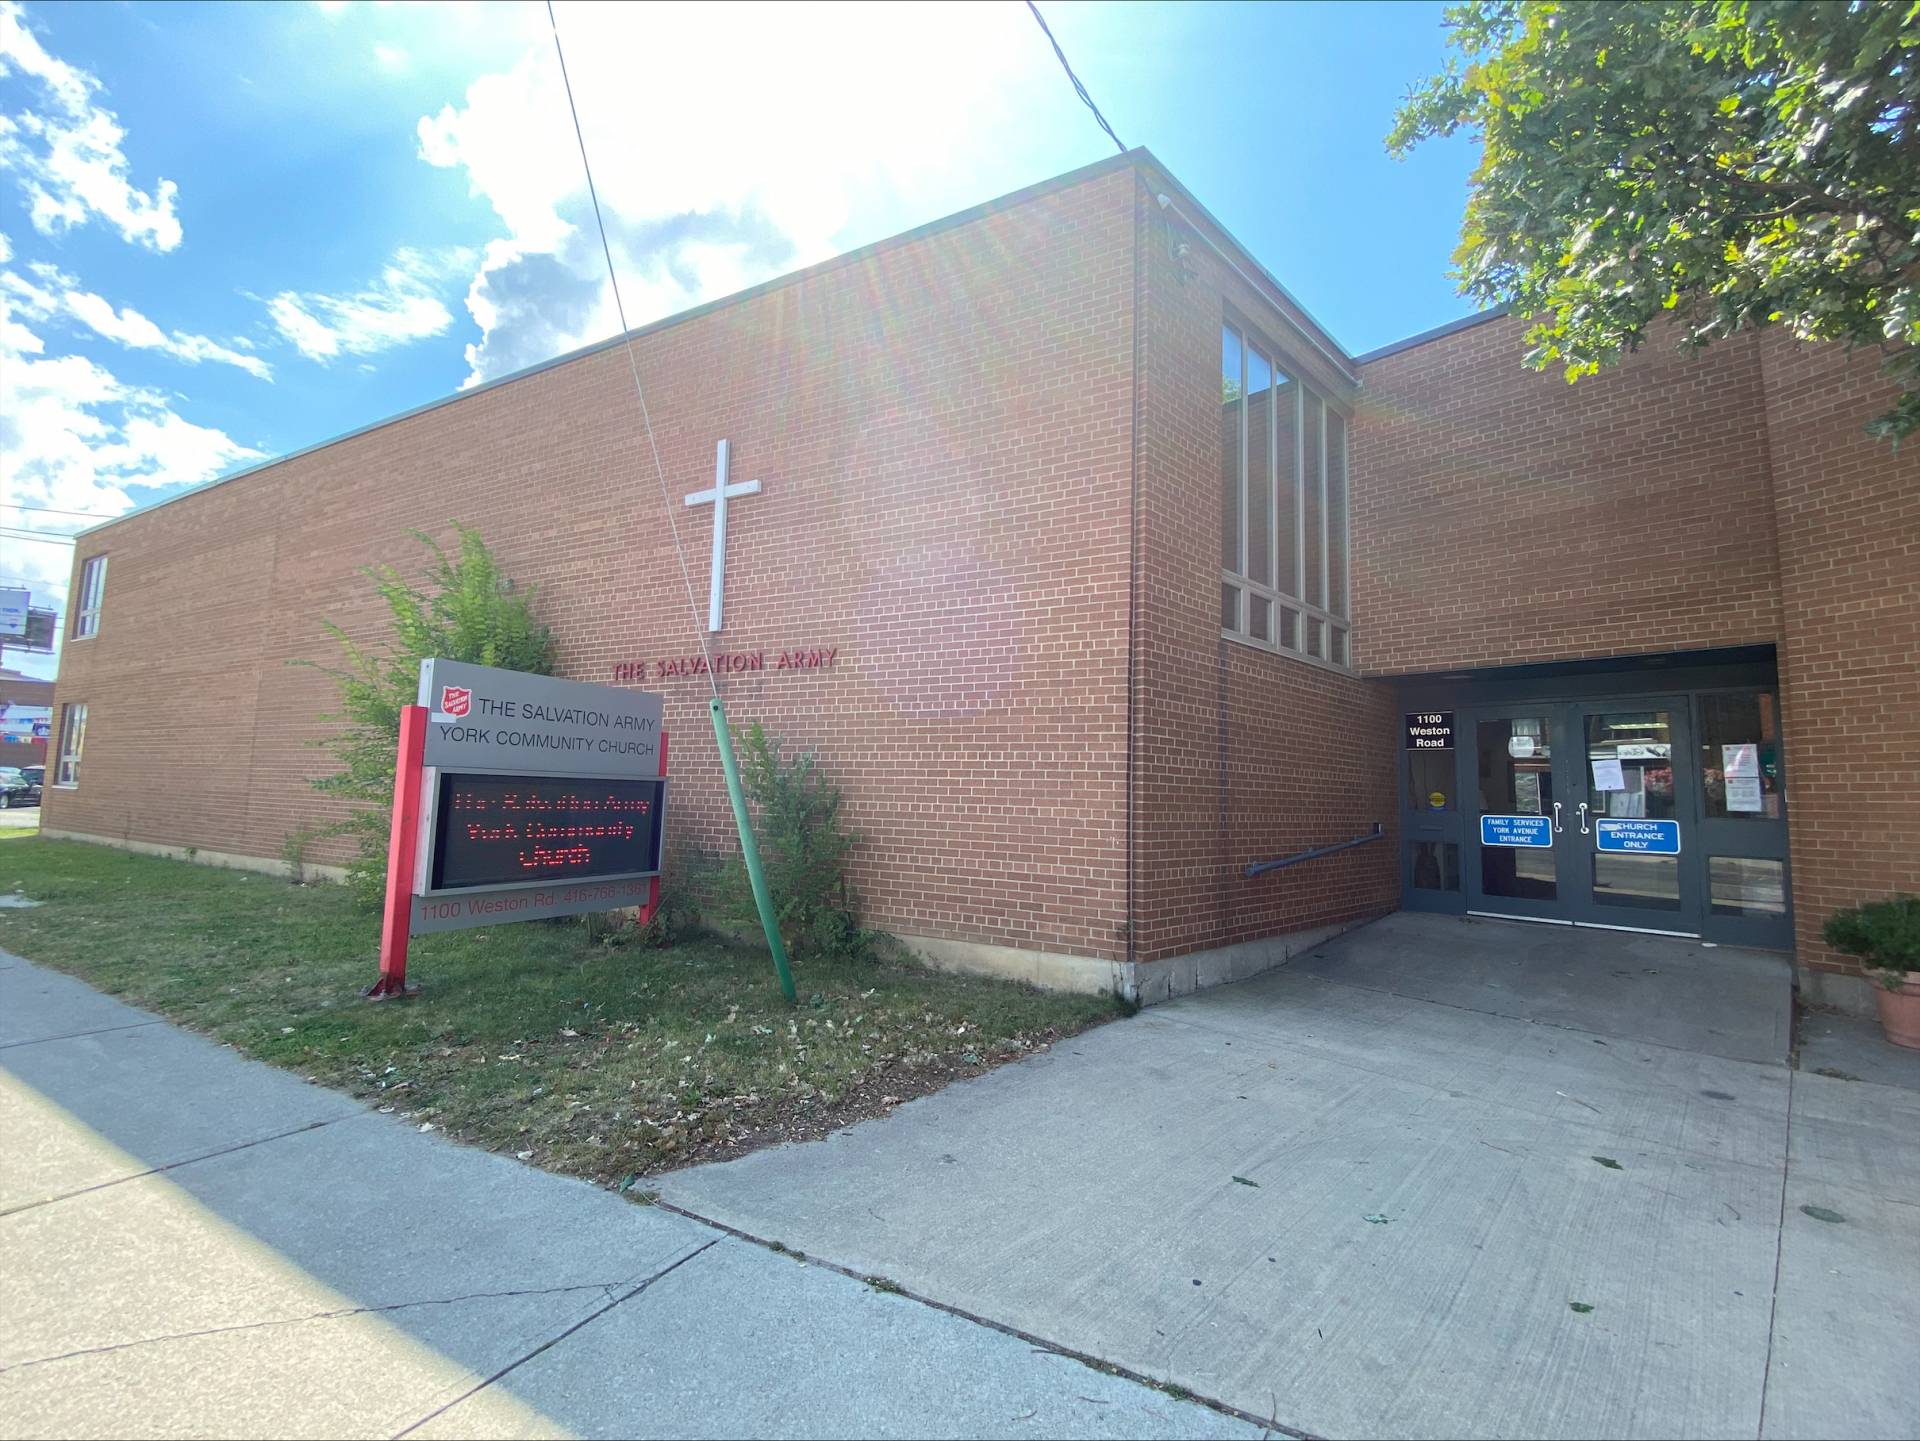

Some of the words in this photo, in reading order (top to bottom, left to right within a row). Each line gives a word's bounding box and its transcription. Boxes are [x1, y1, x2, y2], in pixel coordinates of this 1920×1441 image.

[612, 661, 646, 681] THE
[656, 652, 763, 678] SALVATION
[776, 647, 838, 670] ARMY
[478, 698, 517, 718] THE
[522, 703, 609, 727] SALVATION
[613, 716, 656, 732] ARMY
[1416, 714, 1442, 724] 1100
[1409, 726, 1451, 736] Weston
[440, 725, 490, 744] YORK
[496, 730, 595, 752] COMMUNITY
[598, 739, 655, 756] CHURCH
[1416, 738, 1445, 748] Road
[1487, 818, 1512, 826] FAMILY
[1513, 819, 1544, 827] SERVICES
[1617, 822, 1657, 831] CHURCH
[1512, 827, 1539, 835] AVENUE
[1499, 835, 1533, 843] ENTRANCE
[1611, 832, 1665, 841] ENTRANCE
[1623, 840, 1649, 849] ONLY
[420, 902, 461, 921] 1100
[468, 895, 528, 915] Weston
